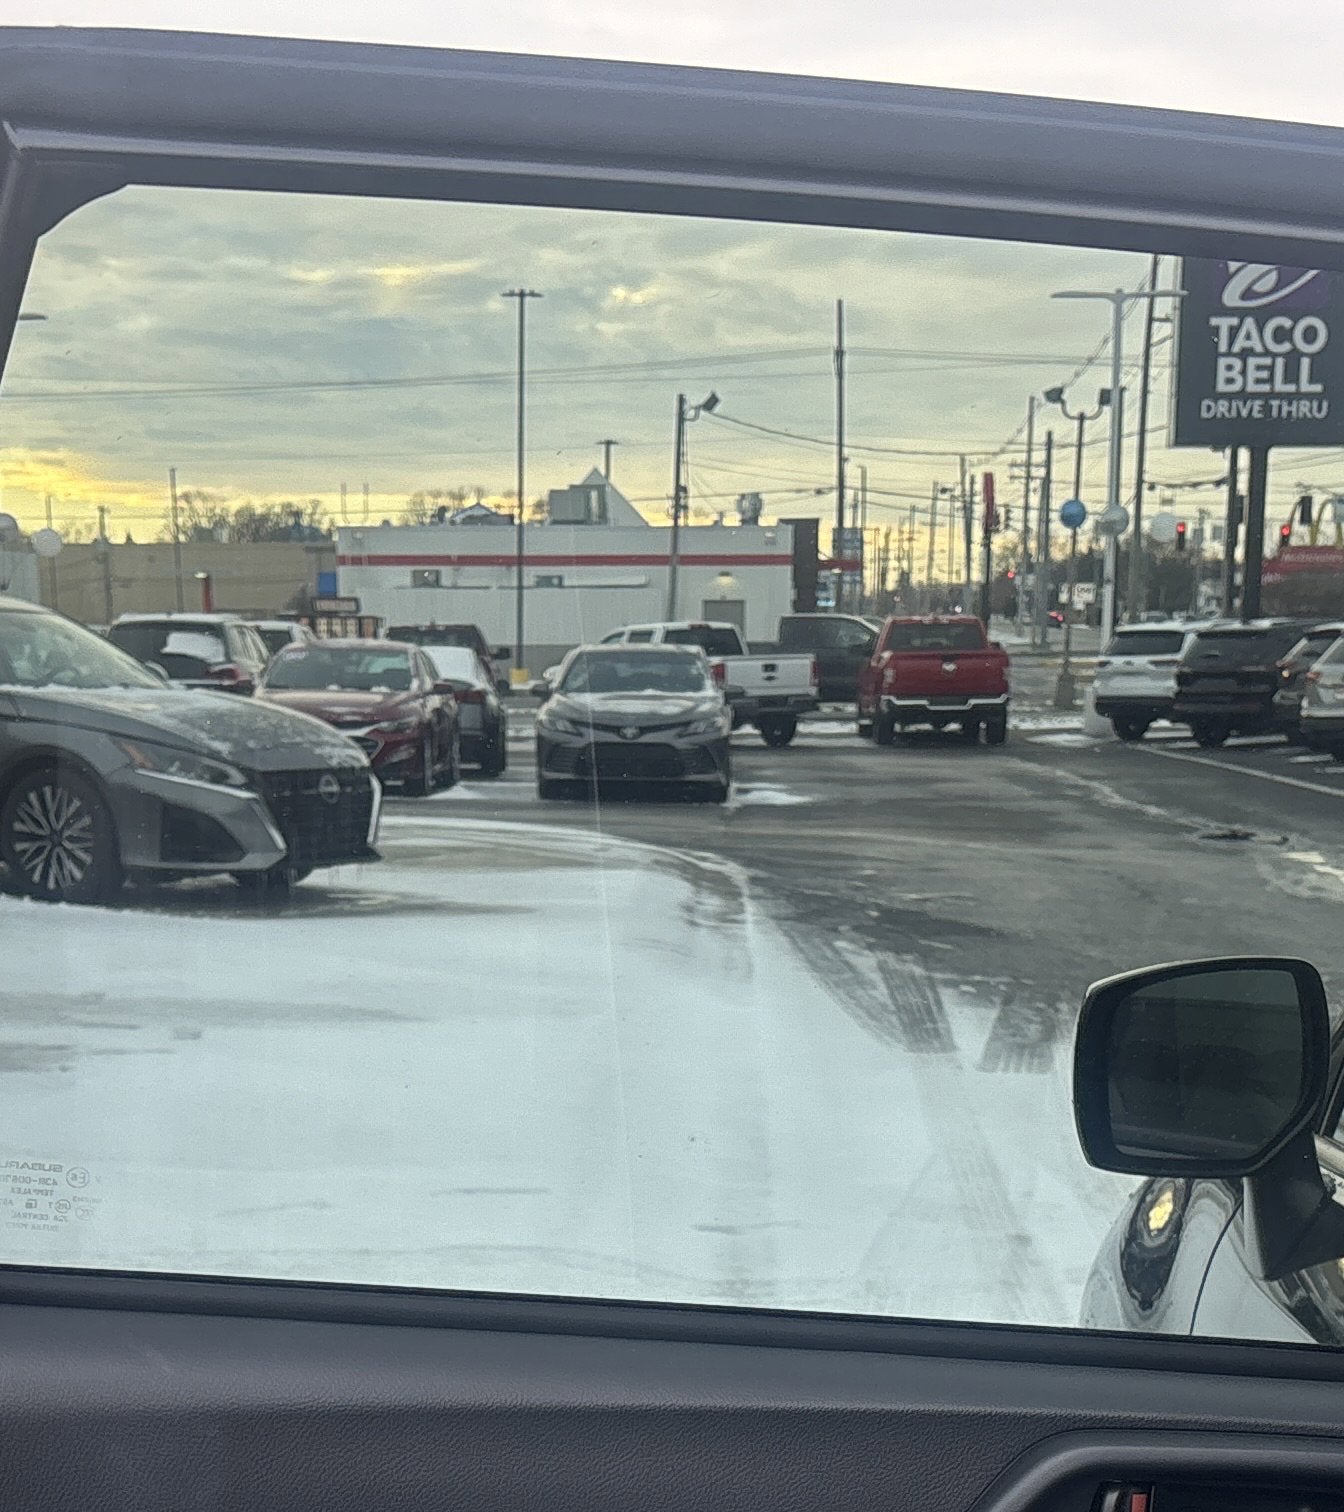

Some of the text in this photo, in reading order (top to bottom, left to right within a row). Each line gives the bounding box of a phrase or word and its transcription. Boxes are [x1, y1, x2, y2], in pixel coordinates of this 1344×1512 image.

[1209, 316, 1329, 354] TACO
[1215, 356, 1324, 394] BELL
[1199, 398, 1329, 420] DRIVE THRU
